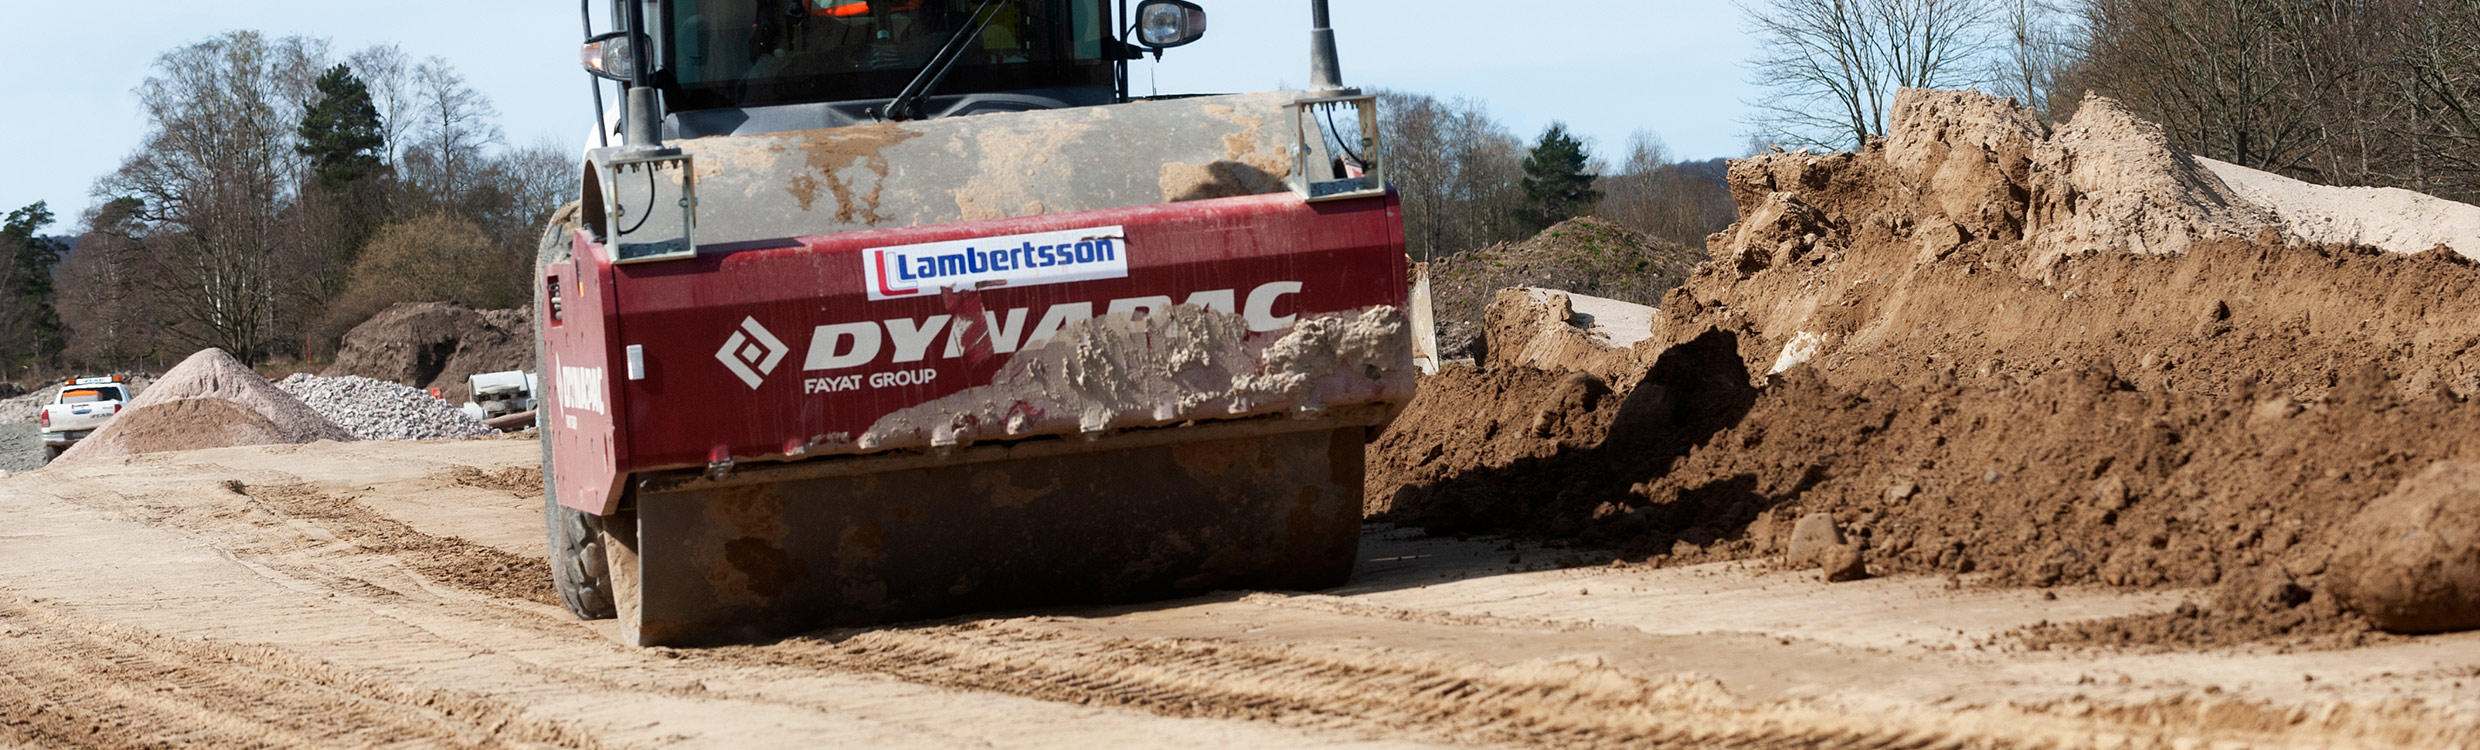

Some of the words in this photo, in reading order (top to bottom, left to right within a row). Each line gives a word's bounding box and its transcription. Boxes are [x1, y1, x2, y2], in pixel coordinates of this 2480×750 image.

[898, 239, 1115, 281] Lambertsson
[804, 374, 863, 394] FAYAT
[869, 368, 937, 389] GROUP
